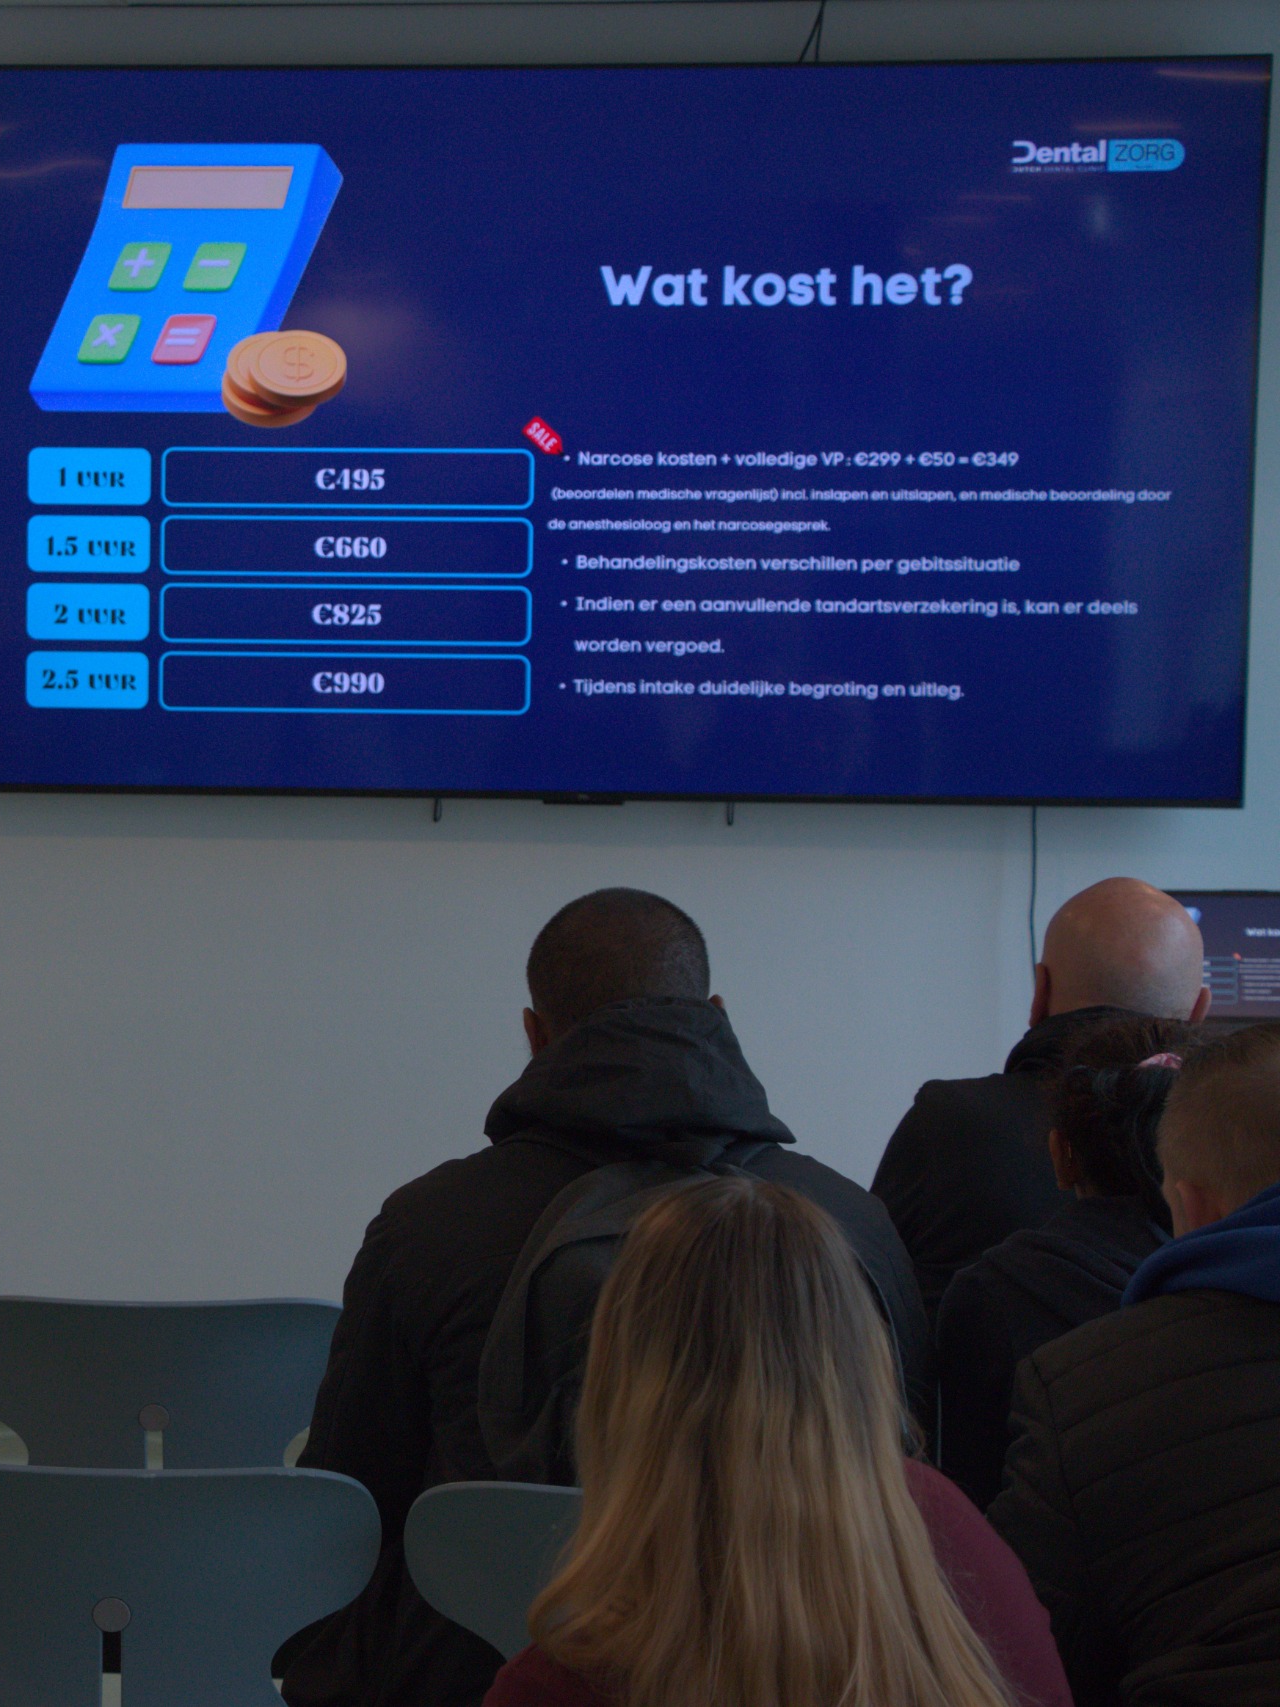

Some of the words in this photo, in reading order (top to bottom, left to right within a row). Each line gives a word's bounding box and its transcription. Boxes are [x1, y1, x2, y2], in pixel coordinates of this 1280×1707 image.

[1011, 139, 1107, 164] Dental
[1114, 143, 1175, 162] ZORG
[600, 265, 708, 306] Wat
[723, 265, 837, 306] kost
[851, 263, 974, 306] het?
[526, 422, 558, 452] SALE
[577, 451, 654, 467] Narcose
[657, 451, 717, 467] kosten
[734, 451, 818, 470] volledige
[853, 451, 901, 467] €299
[919, 451, 956, 467] €50
[971, 451, 1020, 467] €349
[59, 467, 66, 488] 1
[315, 468, 386, 491] €495
[551, 486, 635, 501] (beoordelen
[637, 487, 703, 501] medische
[704, 487, 779, 503] vragenlijst)
[781, 488, 809, 501] incl.
[810, 488, 869, 502] inslapen
[871, 490, 889, 501] en
[891, 488, 957, 503] uitslapen,
[959, 490, 978, 501] en
[980, 488, 1048, 501] medische
[1050, 488, 1136, 504] beoordeling
[1137, 488, 1172, 501] door
[547, 518, 567, 531] de
[568, 518, 672, 534] anesthesioloog
[673, 521, 692, 531] en
[693, 518, 716, 531] het
[717, 519, 832, 534] narcosegesprek.
[47, 535, 79, 556] 1.5
[313, 535, 387, 559] €660
[575, 554, 757, 574] Behandelingskosten
[760, 556, 858, 571] verschillen
[861, 559, 894, 574] per
[896, 556, 1021, 575] gebitssituatie
[53, 603, 68, 625] 2
[311, 603, 383, 626] €825
[575, 596, 635, 612] Indien
[638, 600, 659, 613] er
[661, 600, 697, 613] een
[700, 597, 812, 614] aanvullende
[815, 598, 999, 617] tandartsverzekering
[1001, 599, 1022, 616] is,
[1025, 599, 1060, 615] kan
[1063, 603, 1084, 615] er
[1086, 599, 1139, 615] deels
[574, 638, 642, 653] worden
[645, 638, 726, 657] vergoed.
[42, 669, 79, 690] 2.5
[312, 671, 386, 695] €990
[573, 678, 637, 697] Tijdens
[639, 678, 696, 695] intake
[698, 679, 786, 698] duidelijke
[788, 681, 879, 700] begroting
[882, 684, 907, 698] en
[909, 682, 966, 701] uitleg.
